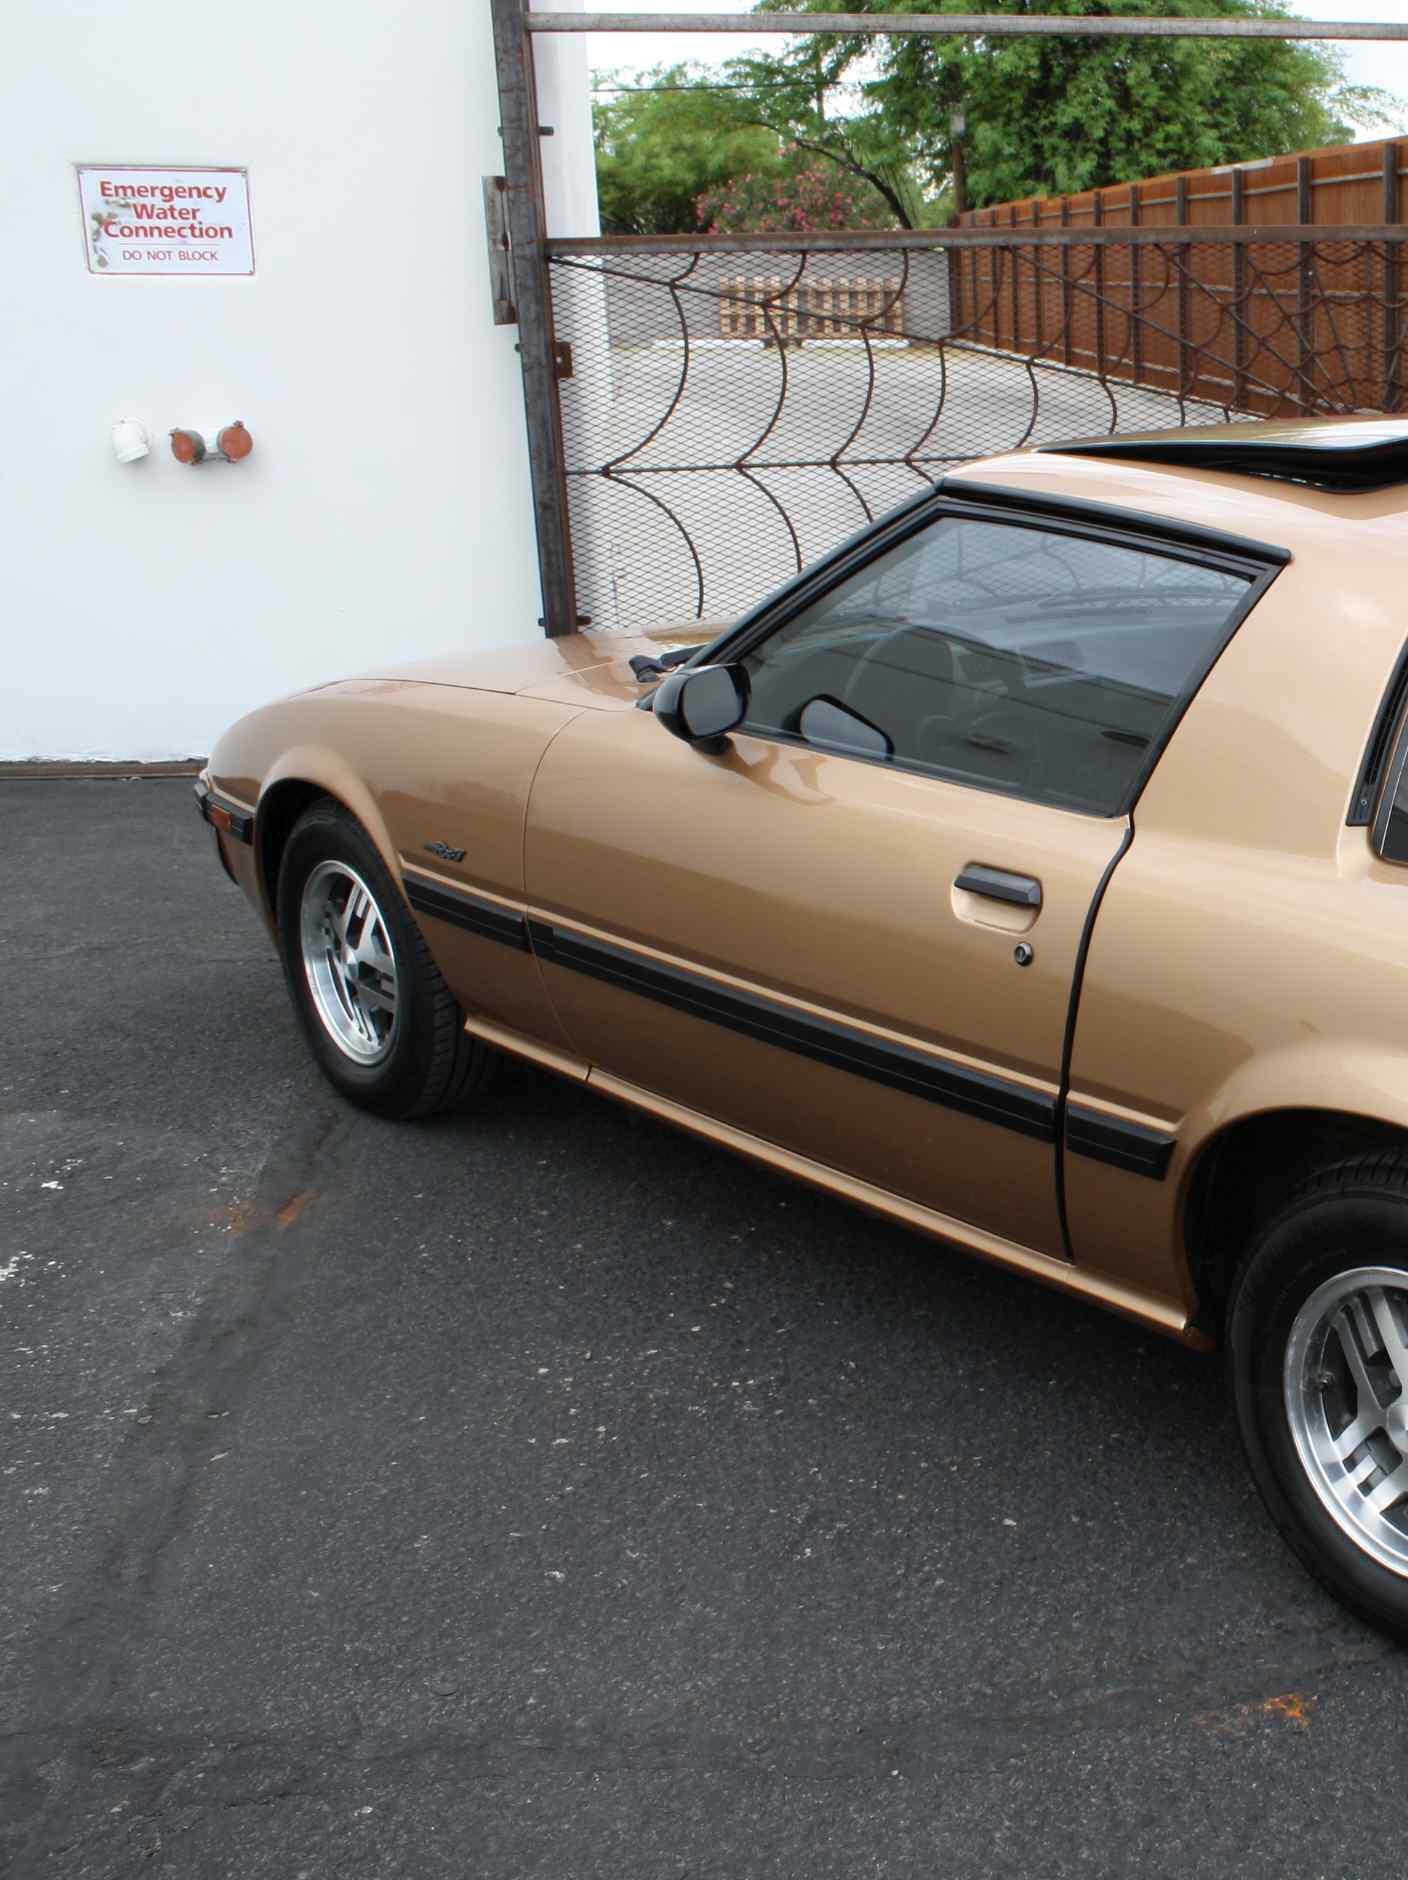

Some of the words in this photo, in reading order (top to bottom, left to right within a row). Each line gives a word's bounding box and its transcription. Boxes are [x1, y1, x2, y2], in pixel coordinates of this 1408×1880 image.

[100, 181, 227, 202] Emergency
[131, 203, 201, 220] Water
[103, 221, 233, 239] Connection
[122, 250, 142, 261] DO
[147, 250, 173, 261] NOT
[178, 250, 218, 261] BLOCK
